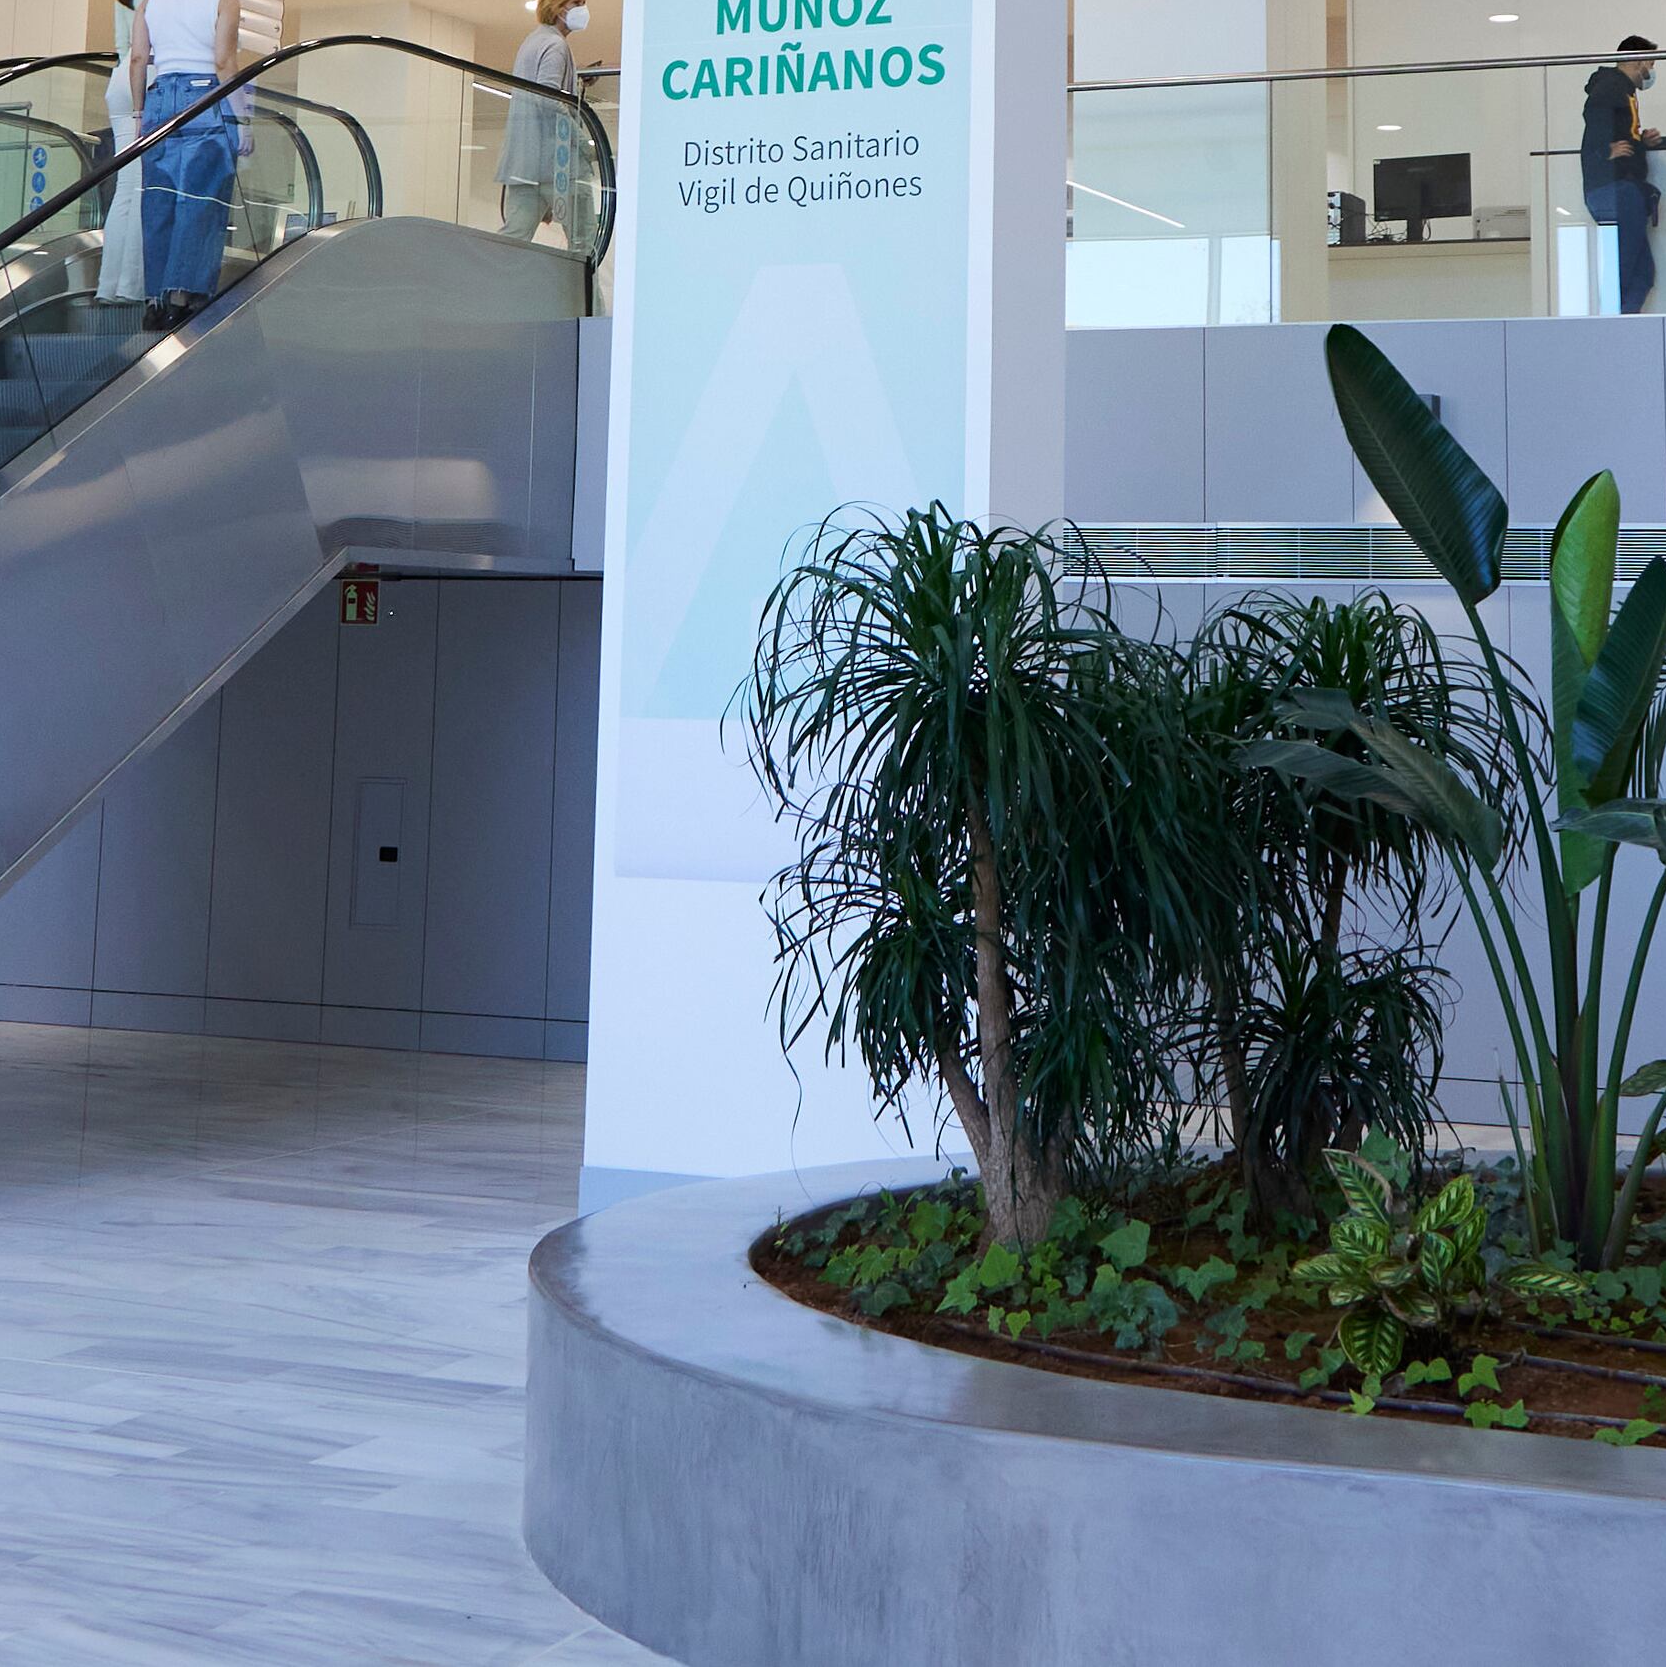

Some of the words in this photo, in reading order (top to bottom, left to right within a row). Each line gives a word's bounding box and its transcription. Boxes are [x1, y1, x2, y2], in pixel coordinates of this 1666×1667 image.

[661, 42, 946, 101] CARIÑANOS
[684, 137, 784, 167] Distrito
[792, 129, 920, 162] Sanitario
[678, 176, 736, 214] Vigil
[745, 176, 779, 204] de
[788, 171, 923, 208] Quiñones
